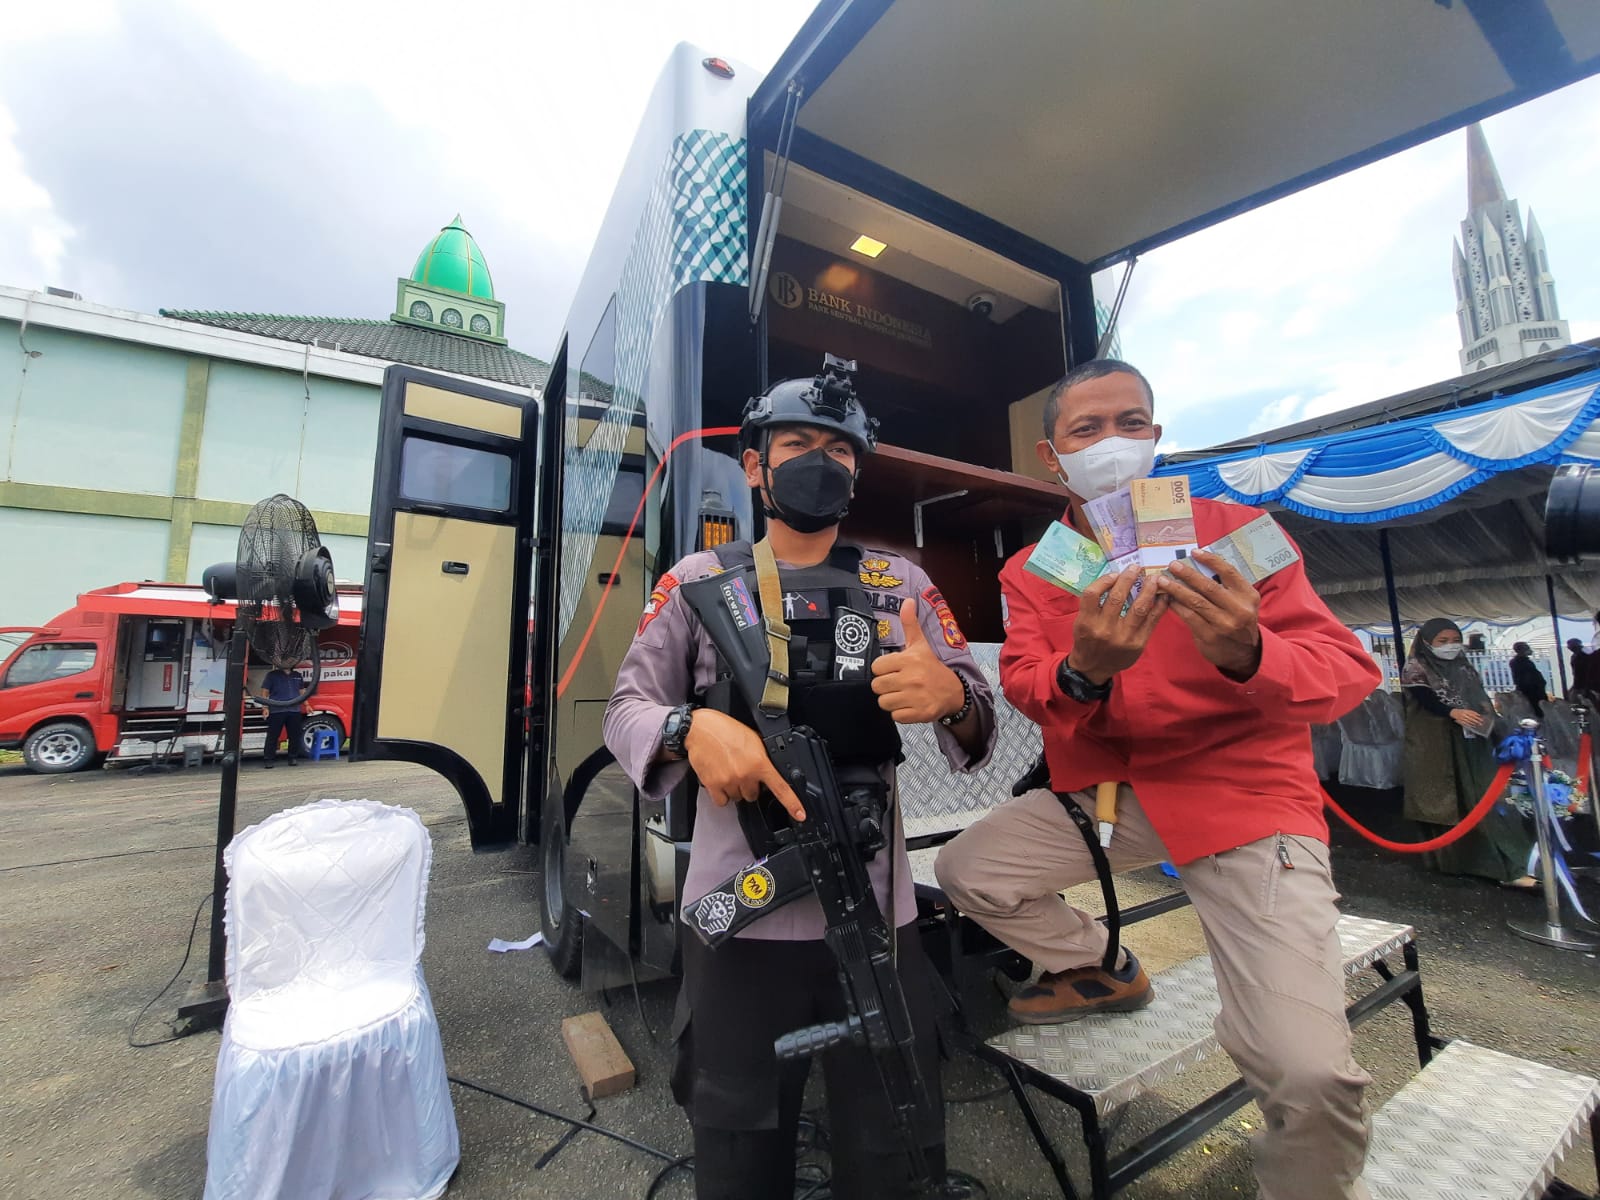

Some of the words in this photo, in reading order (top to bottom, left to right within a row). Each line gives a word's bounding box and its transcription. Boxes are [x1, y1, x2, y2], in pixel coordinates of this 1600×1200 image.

[808, 288, 852, 313] BANK
[1174, 481, 1185, 504] 5000
[1267, 550, 1292, 568] 2000
[723, 585, 747, 627] forward
[323, 669, 353, 679] pakai
